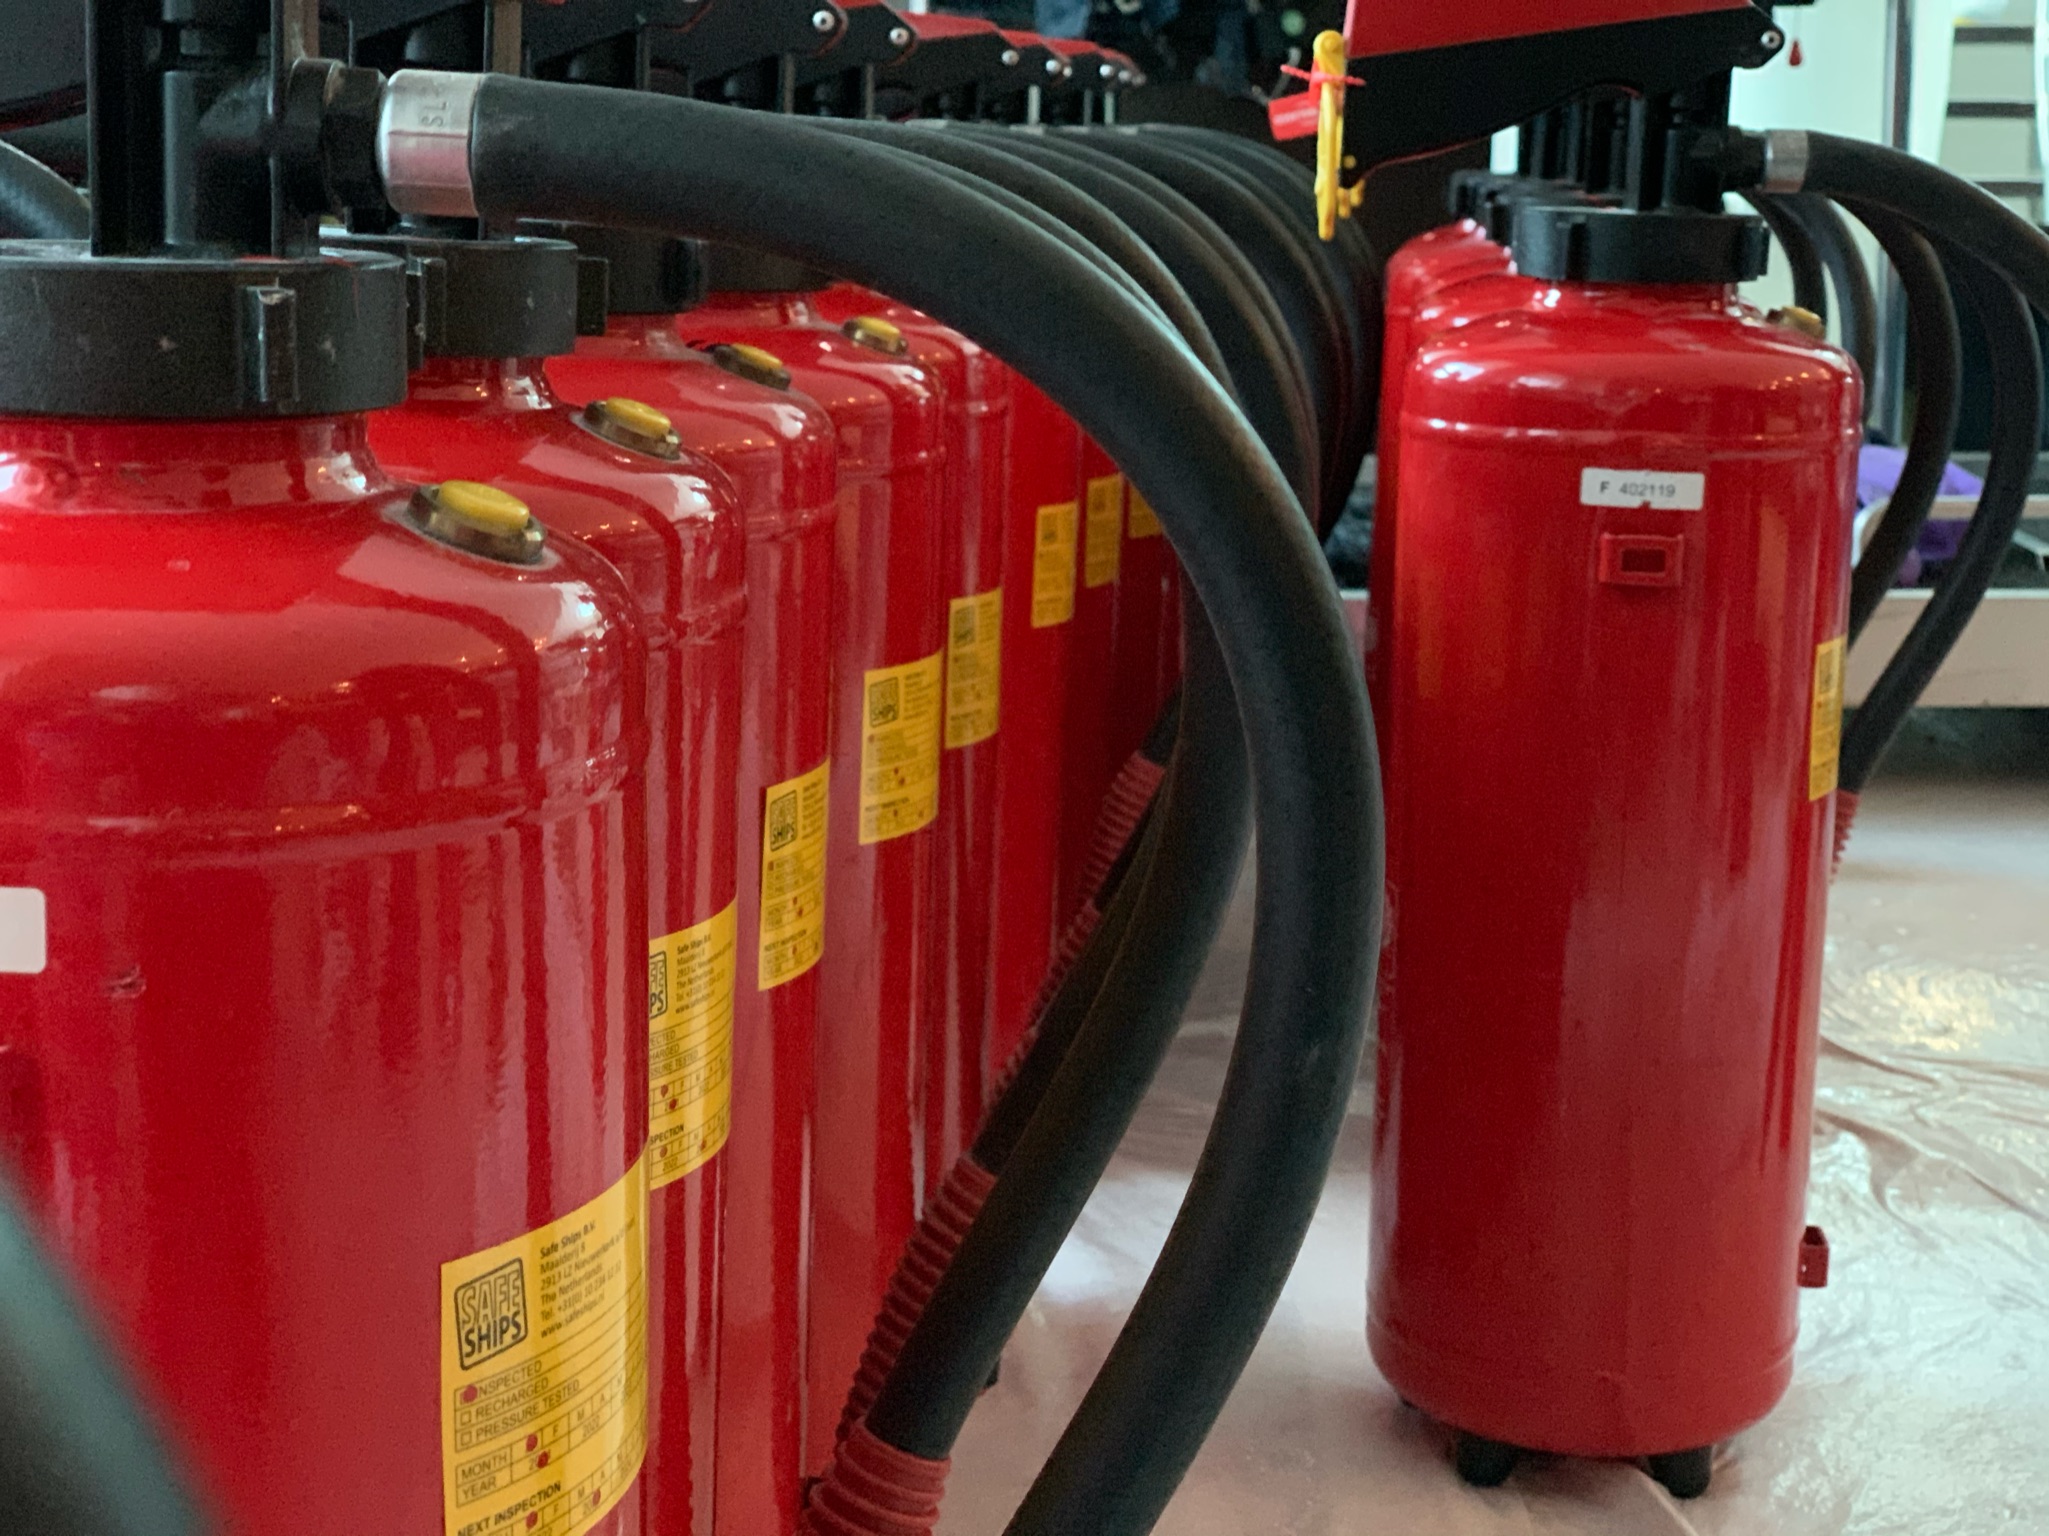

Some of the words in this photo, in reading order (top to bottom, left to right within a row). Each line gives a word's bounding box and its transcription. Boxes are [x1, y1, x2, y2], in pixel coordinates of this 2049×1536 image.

[1600, 480, 1610, 493] F
[1618, 482, 1676, 498] 402119
[540, 1242, 559, 1260] Safe
[561, 1231, 582, 1249] Ships
[462, 1268, 520, 1331] SAFE
[464, 1310, 521, 1358] SHIPS
[475, 1377, 549, 1420] RECHARGED
[478, 1360, 543, 1398] NSPECTED
[475, 1401, 540, 1438] PRESSURE
[542, 1379, 580, 1411] TESTED
[461, 1451, 509, 1480] MONTH
[461, 1476, 497, 1500] YEAR
[457, 1517, 491, 1536] NEXT
[494, 1481, 562, 1525] INSPECTION
